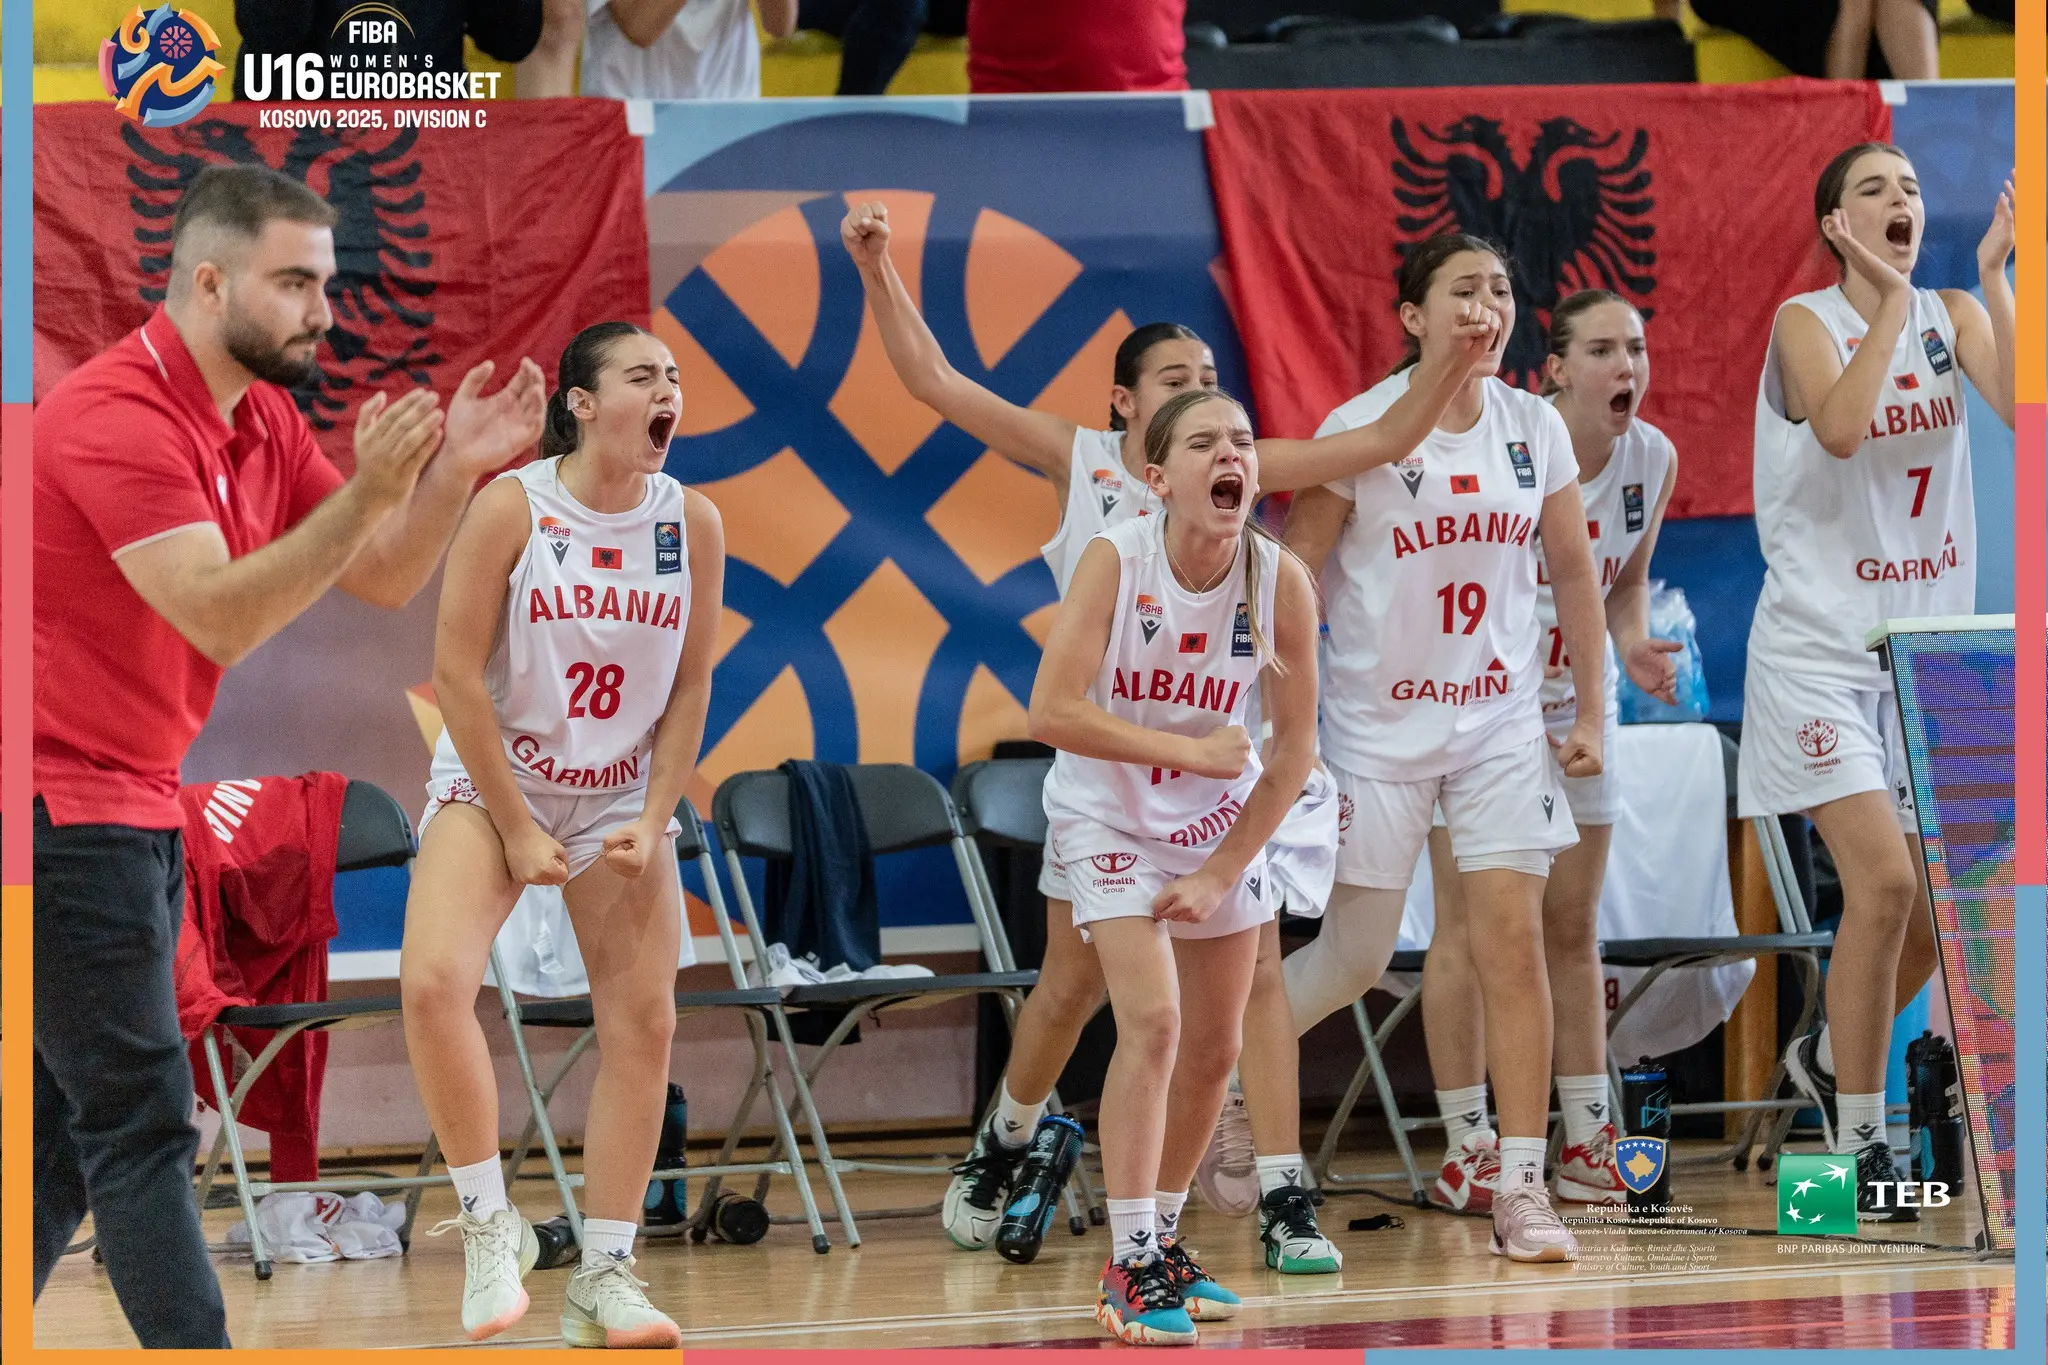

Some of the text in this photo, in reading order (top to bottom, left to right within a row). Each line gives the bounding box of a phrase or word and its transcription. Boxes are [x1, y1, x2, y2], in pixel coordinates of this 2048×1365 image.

[1863, 395, 1960, 440] LBANI
[1516, 467, 1533, 477] FIBA
[1907, 465, 1933, 518] 7
[547, 525, 571, 537] FSHB
[1392, 511, 1533, 559] ALBANIA
[659, 552, 677, 561] FIBA
[529, 584, 681, 631] ALBANIA
[1139, 603, 1163, 615] FSHB
[1436, 581, 1488, 636] 19
[1235, 633, 1253, 643] FIBA
[565, 661, 625, 720] 28
[1111, 667, 1243, 714] ALBANI
[511, 735, 639, 788] GARMIN
[1169, 799, 1243, 847] RMIN
[1092, 877, 1136, 889] FitHealth
[1102, 887, 1125, 895] Group
